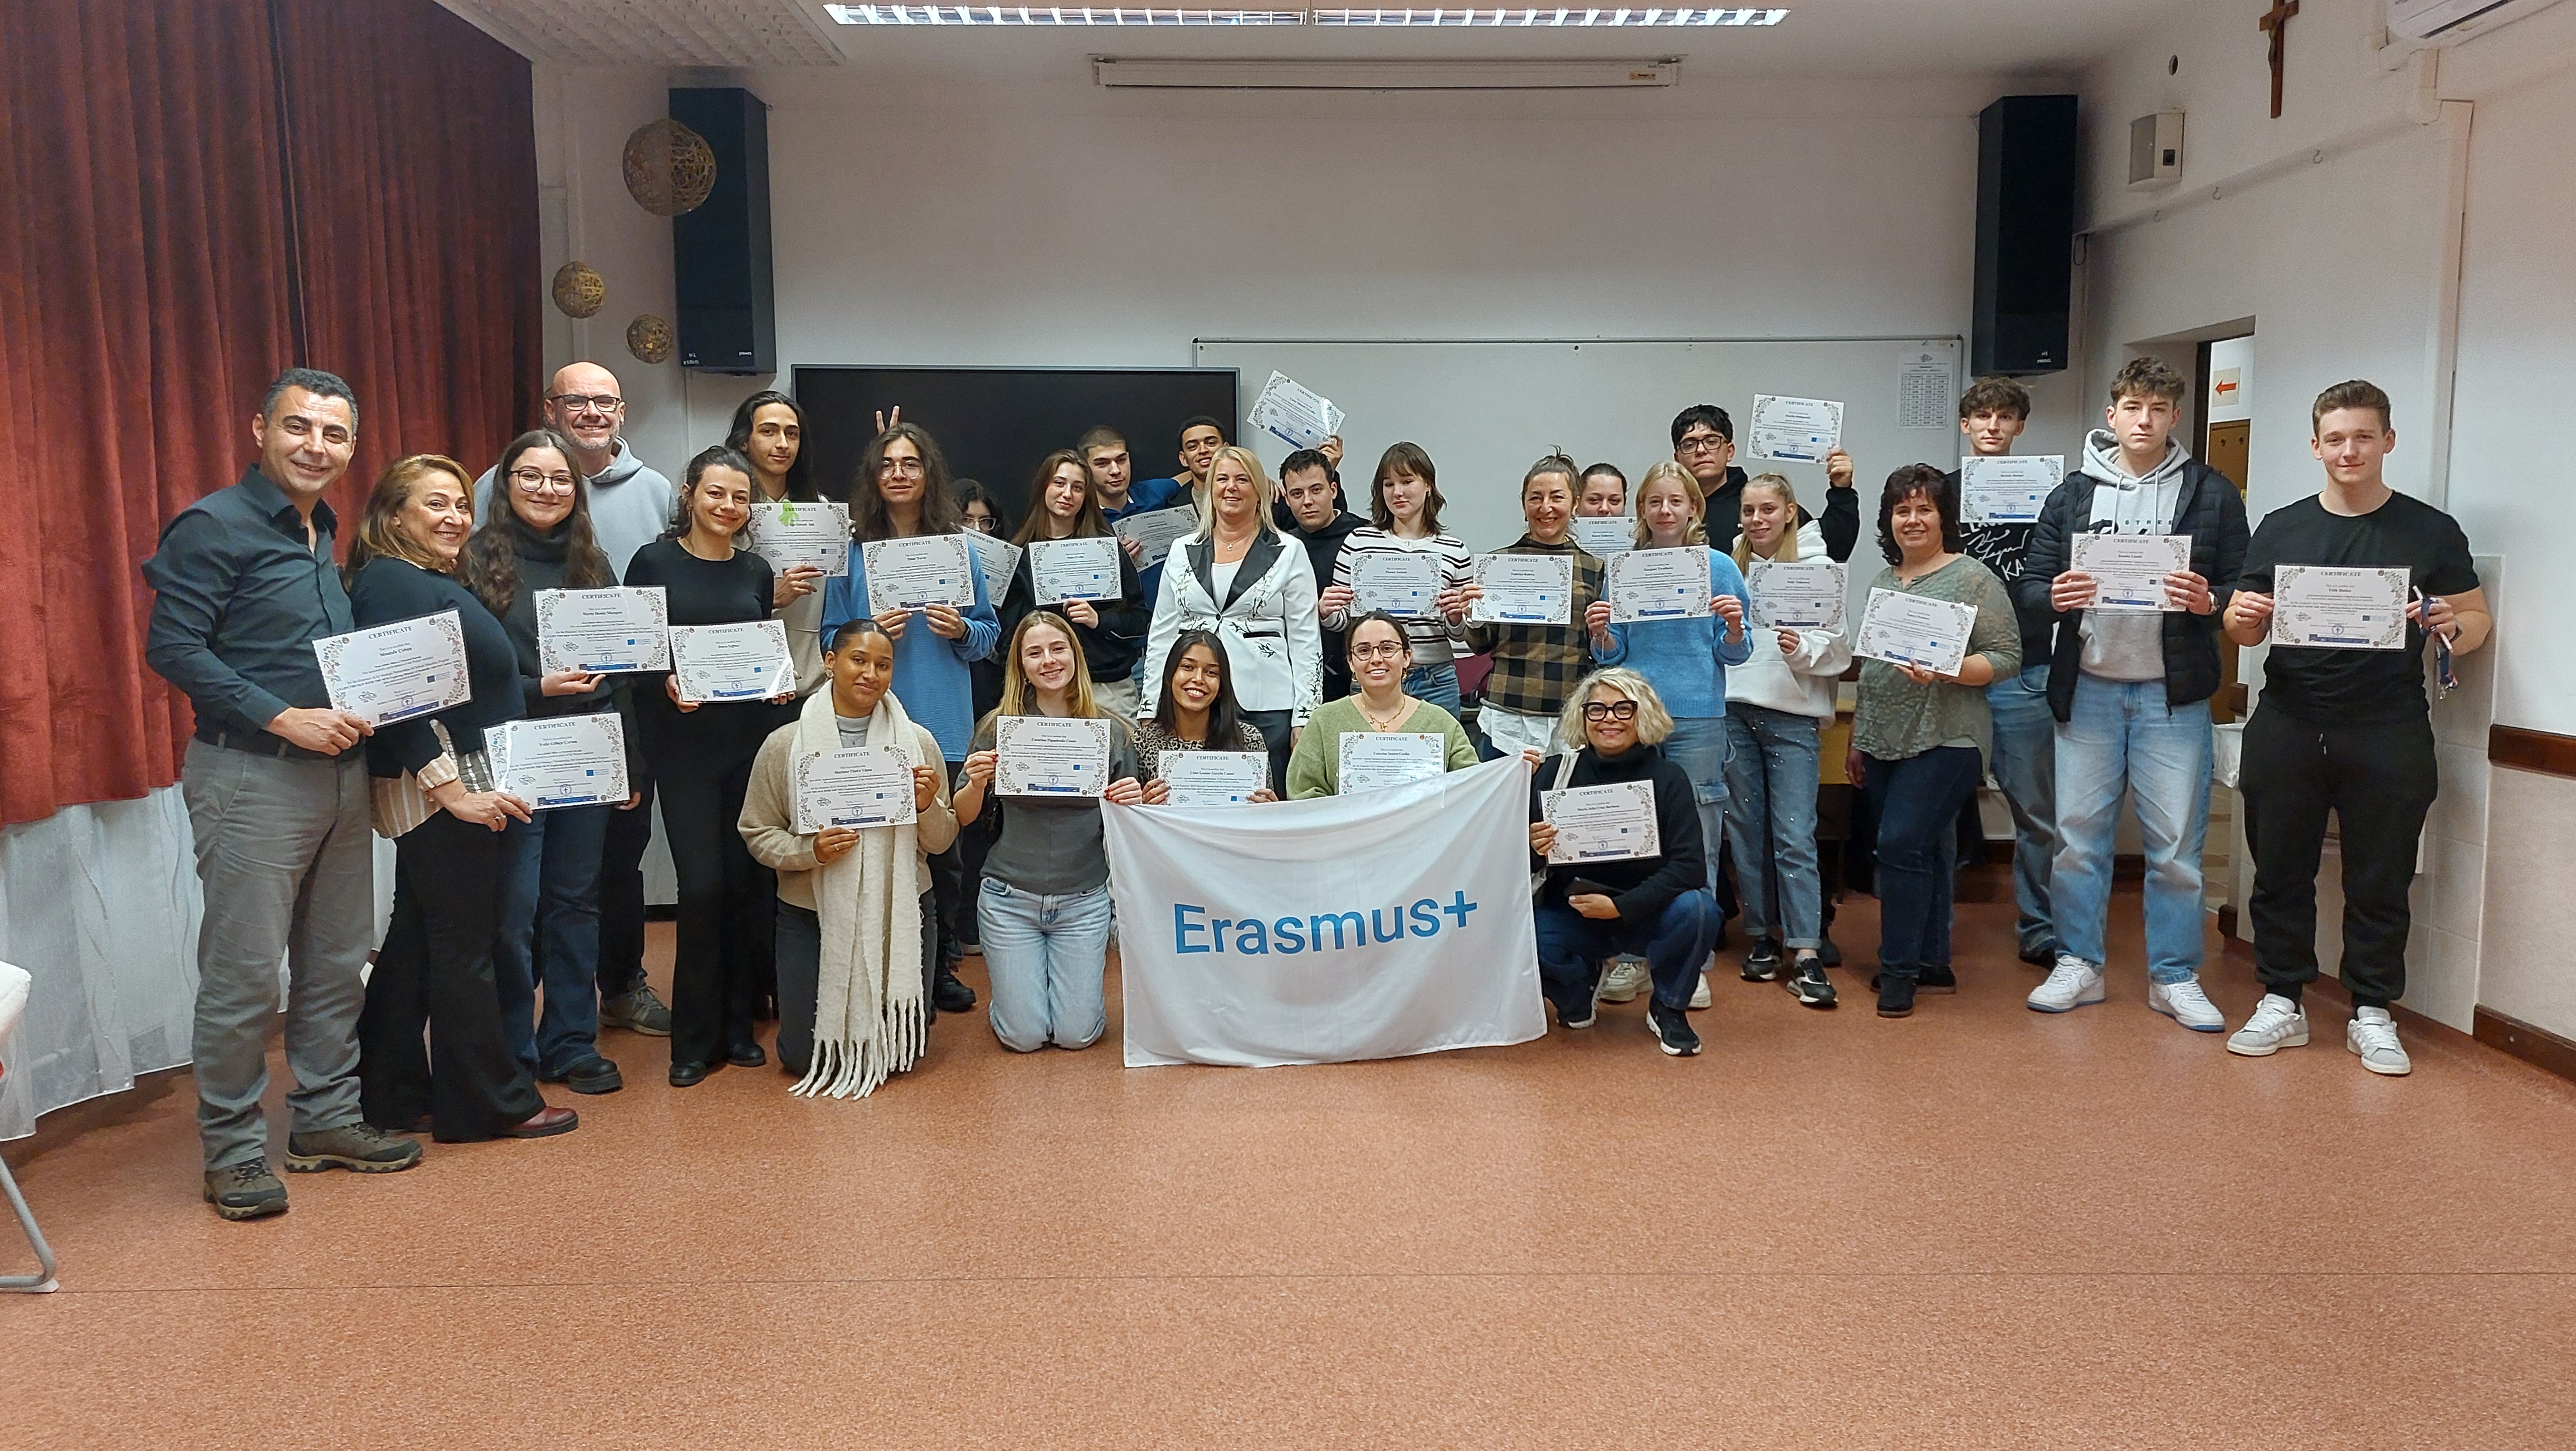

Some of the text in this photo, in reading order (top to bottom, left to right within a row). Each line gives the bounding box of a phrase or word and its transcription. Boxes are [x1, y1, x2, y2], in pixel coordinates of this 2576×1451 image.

[1905, 598, 1937, 607] CERTIFICATE
[368, 626, 412, 640] CERTIFICATE
[1174, 890, 1478, 955] Erasmus+
